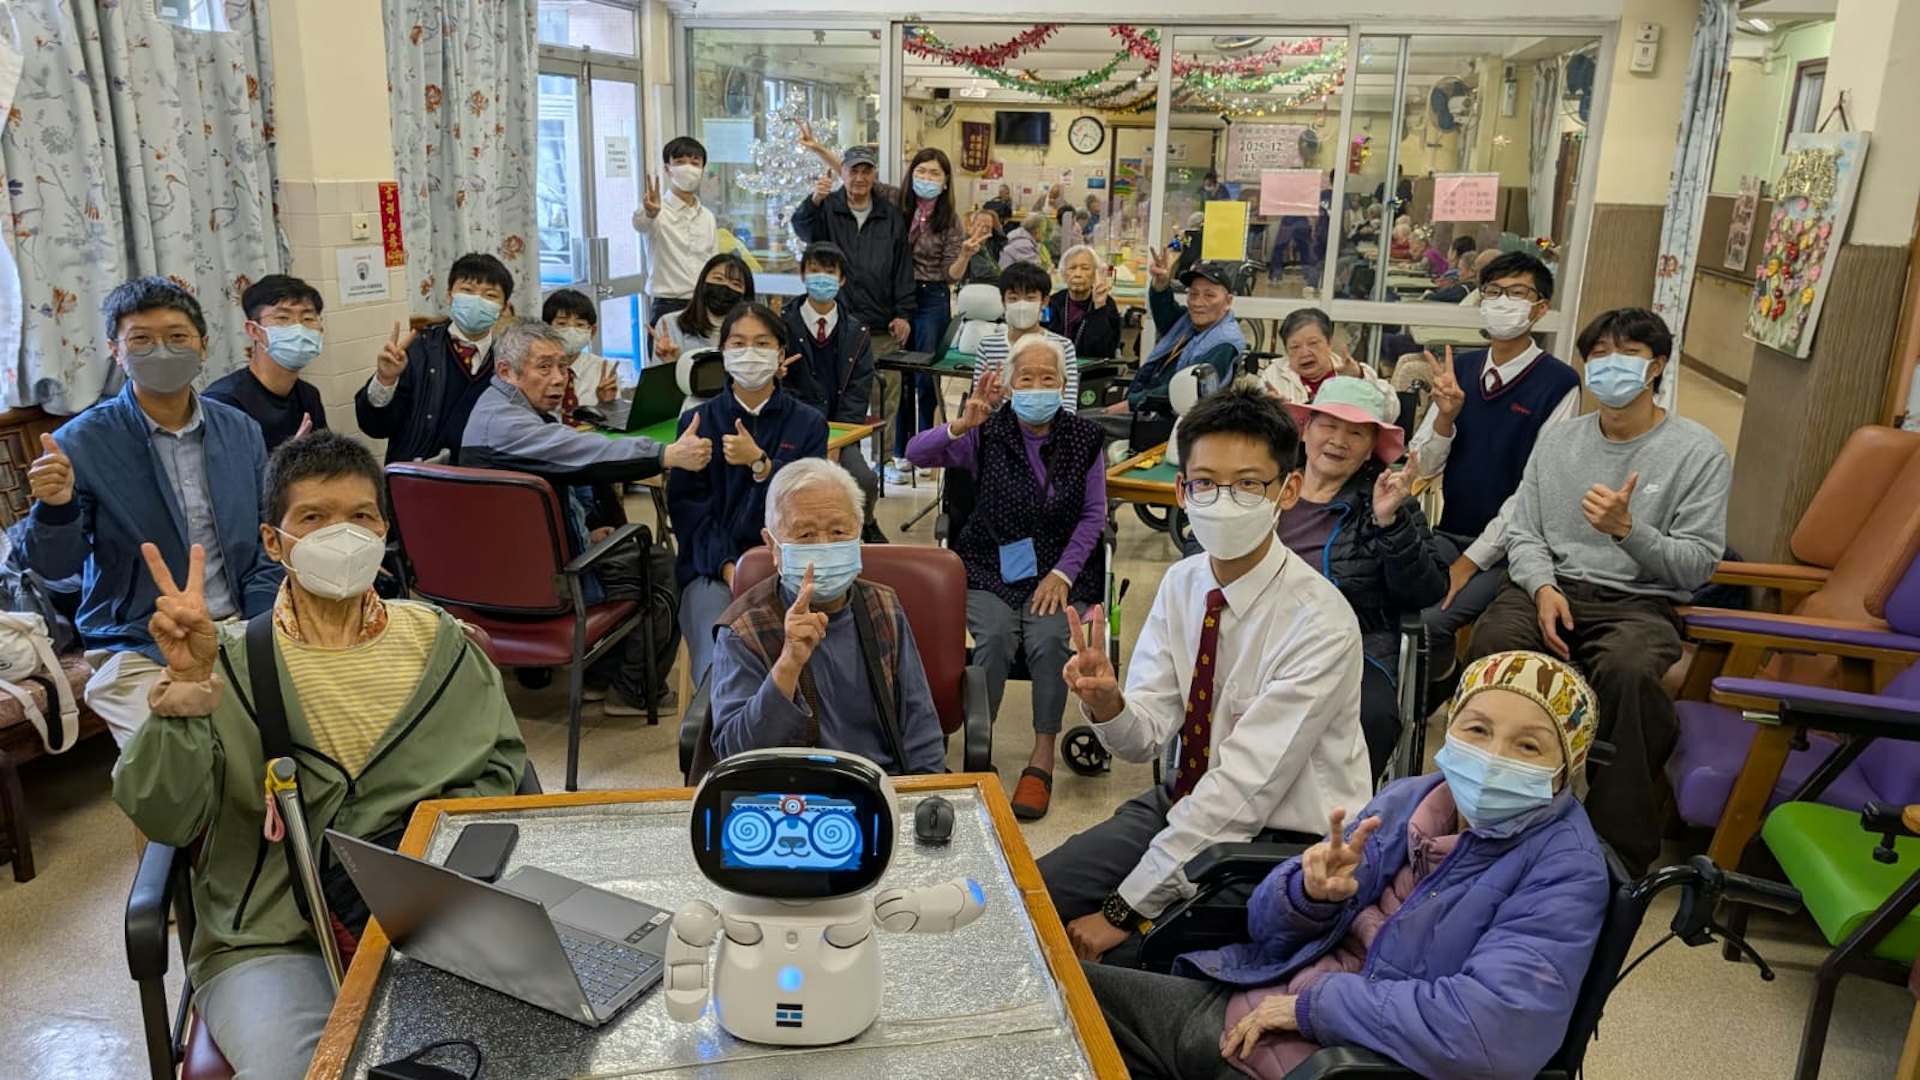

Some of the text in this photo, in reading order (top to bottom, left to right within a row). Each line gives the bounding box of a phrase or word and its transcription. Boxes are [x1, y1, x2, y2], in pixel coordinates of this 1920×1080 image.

[1240, 141, 1282, 152] 2025 12
[1244, 154, 1255, 163] 13
